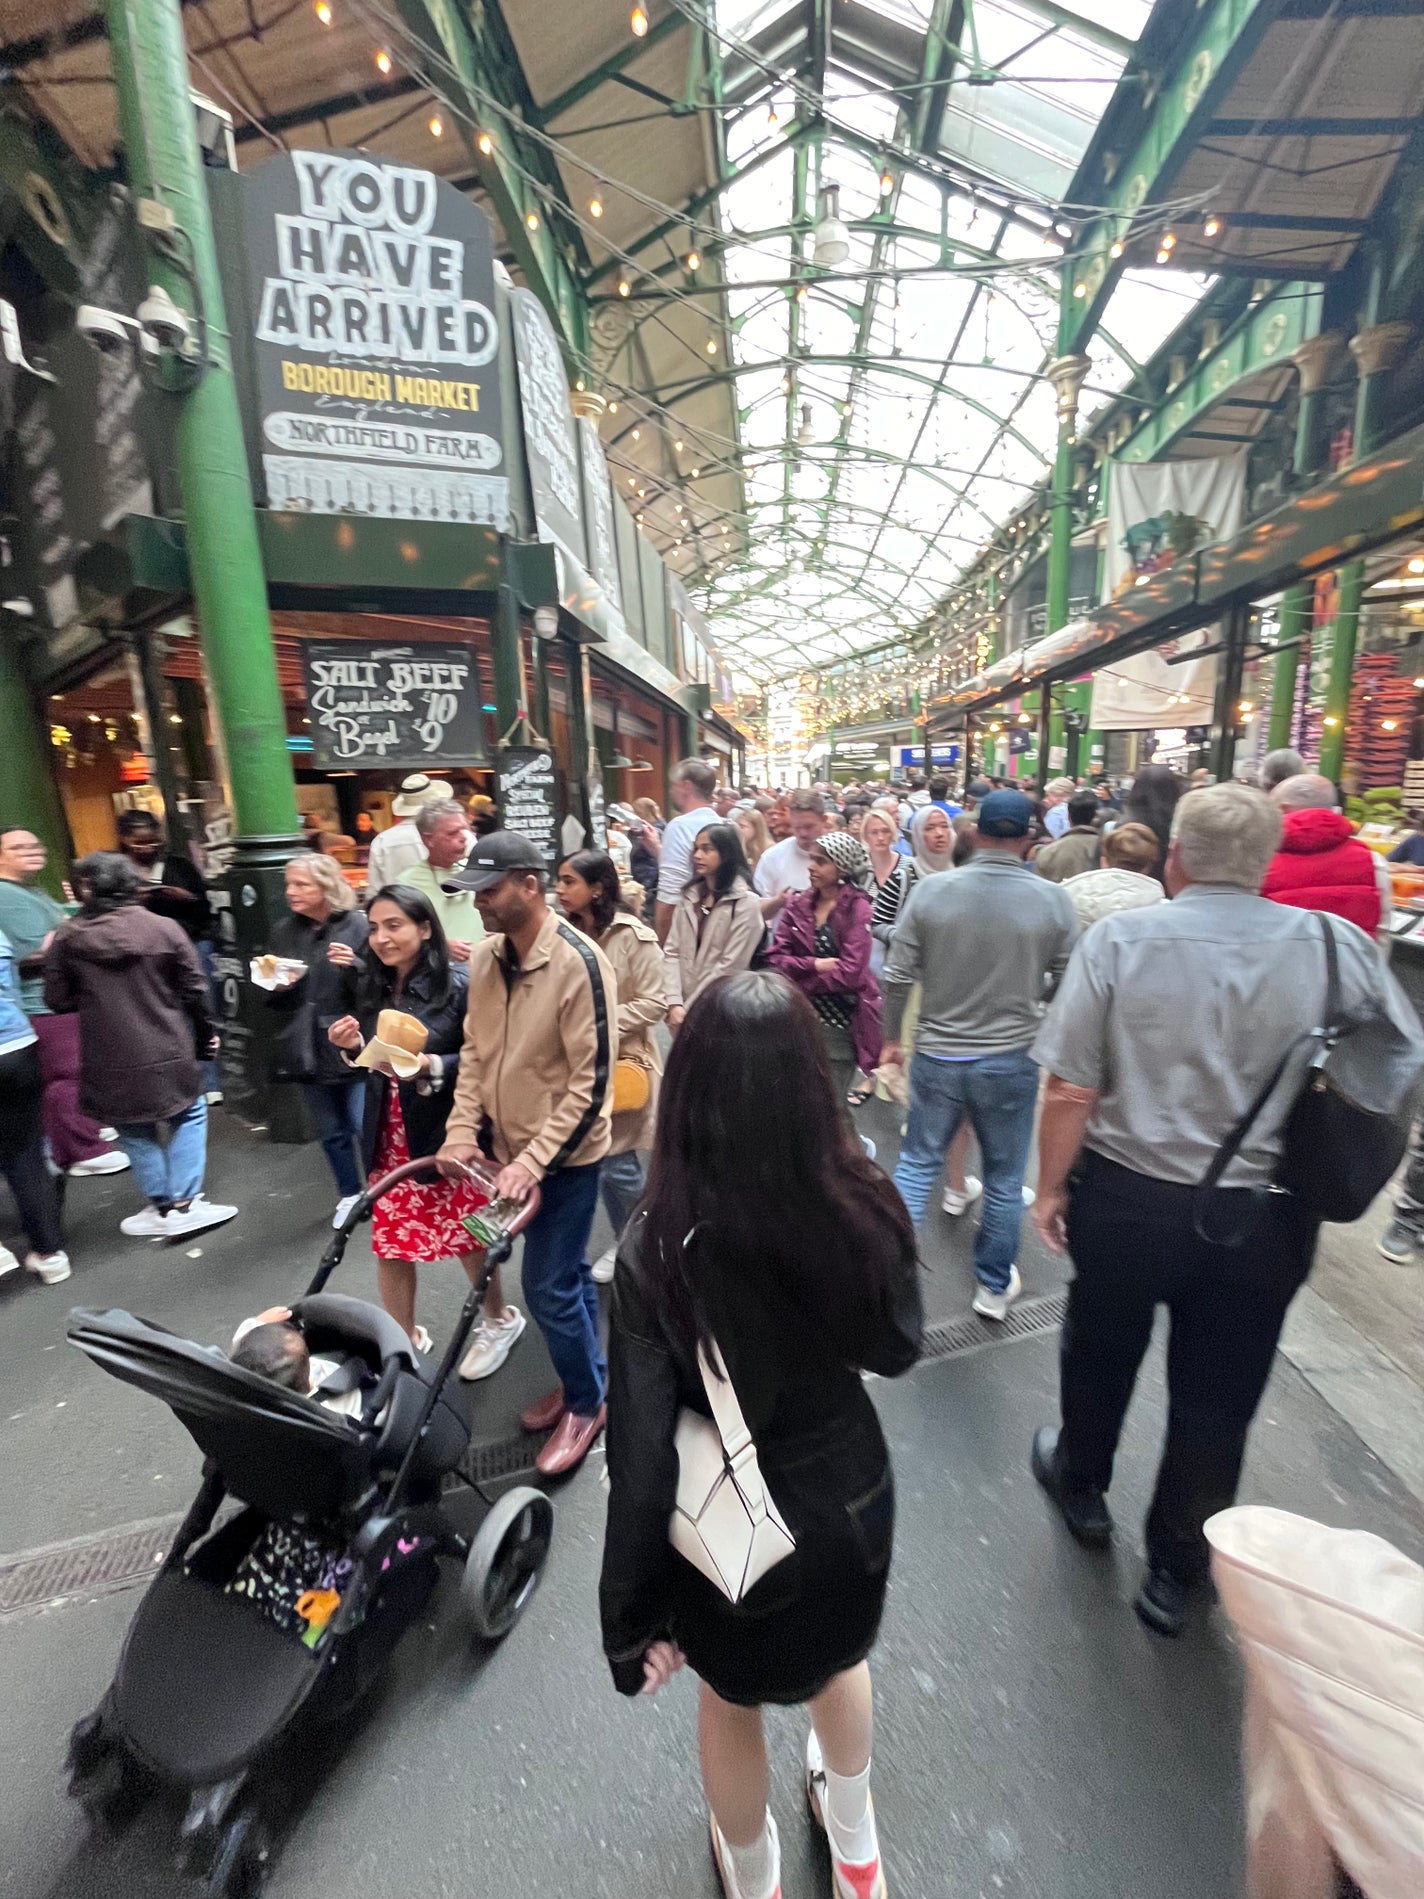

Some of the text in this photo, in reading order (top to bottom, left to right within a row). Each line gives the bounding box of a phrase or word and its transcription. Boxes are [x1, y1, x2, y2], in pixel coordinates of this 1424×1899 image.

[296, 155, 432, 232] YOU
[281, 219, 461, 297] HAVE
[262, 283, 494, 360] ARRIVED
[281, 360, 481, 412] BOROUGH MARKET
[288, 419, 484, 460] NORTHFIELD FARM
[310, 660, 469, 693] SALT BEEF
[311, 686, 414, 725] Sandwich
